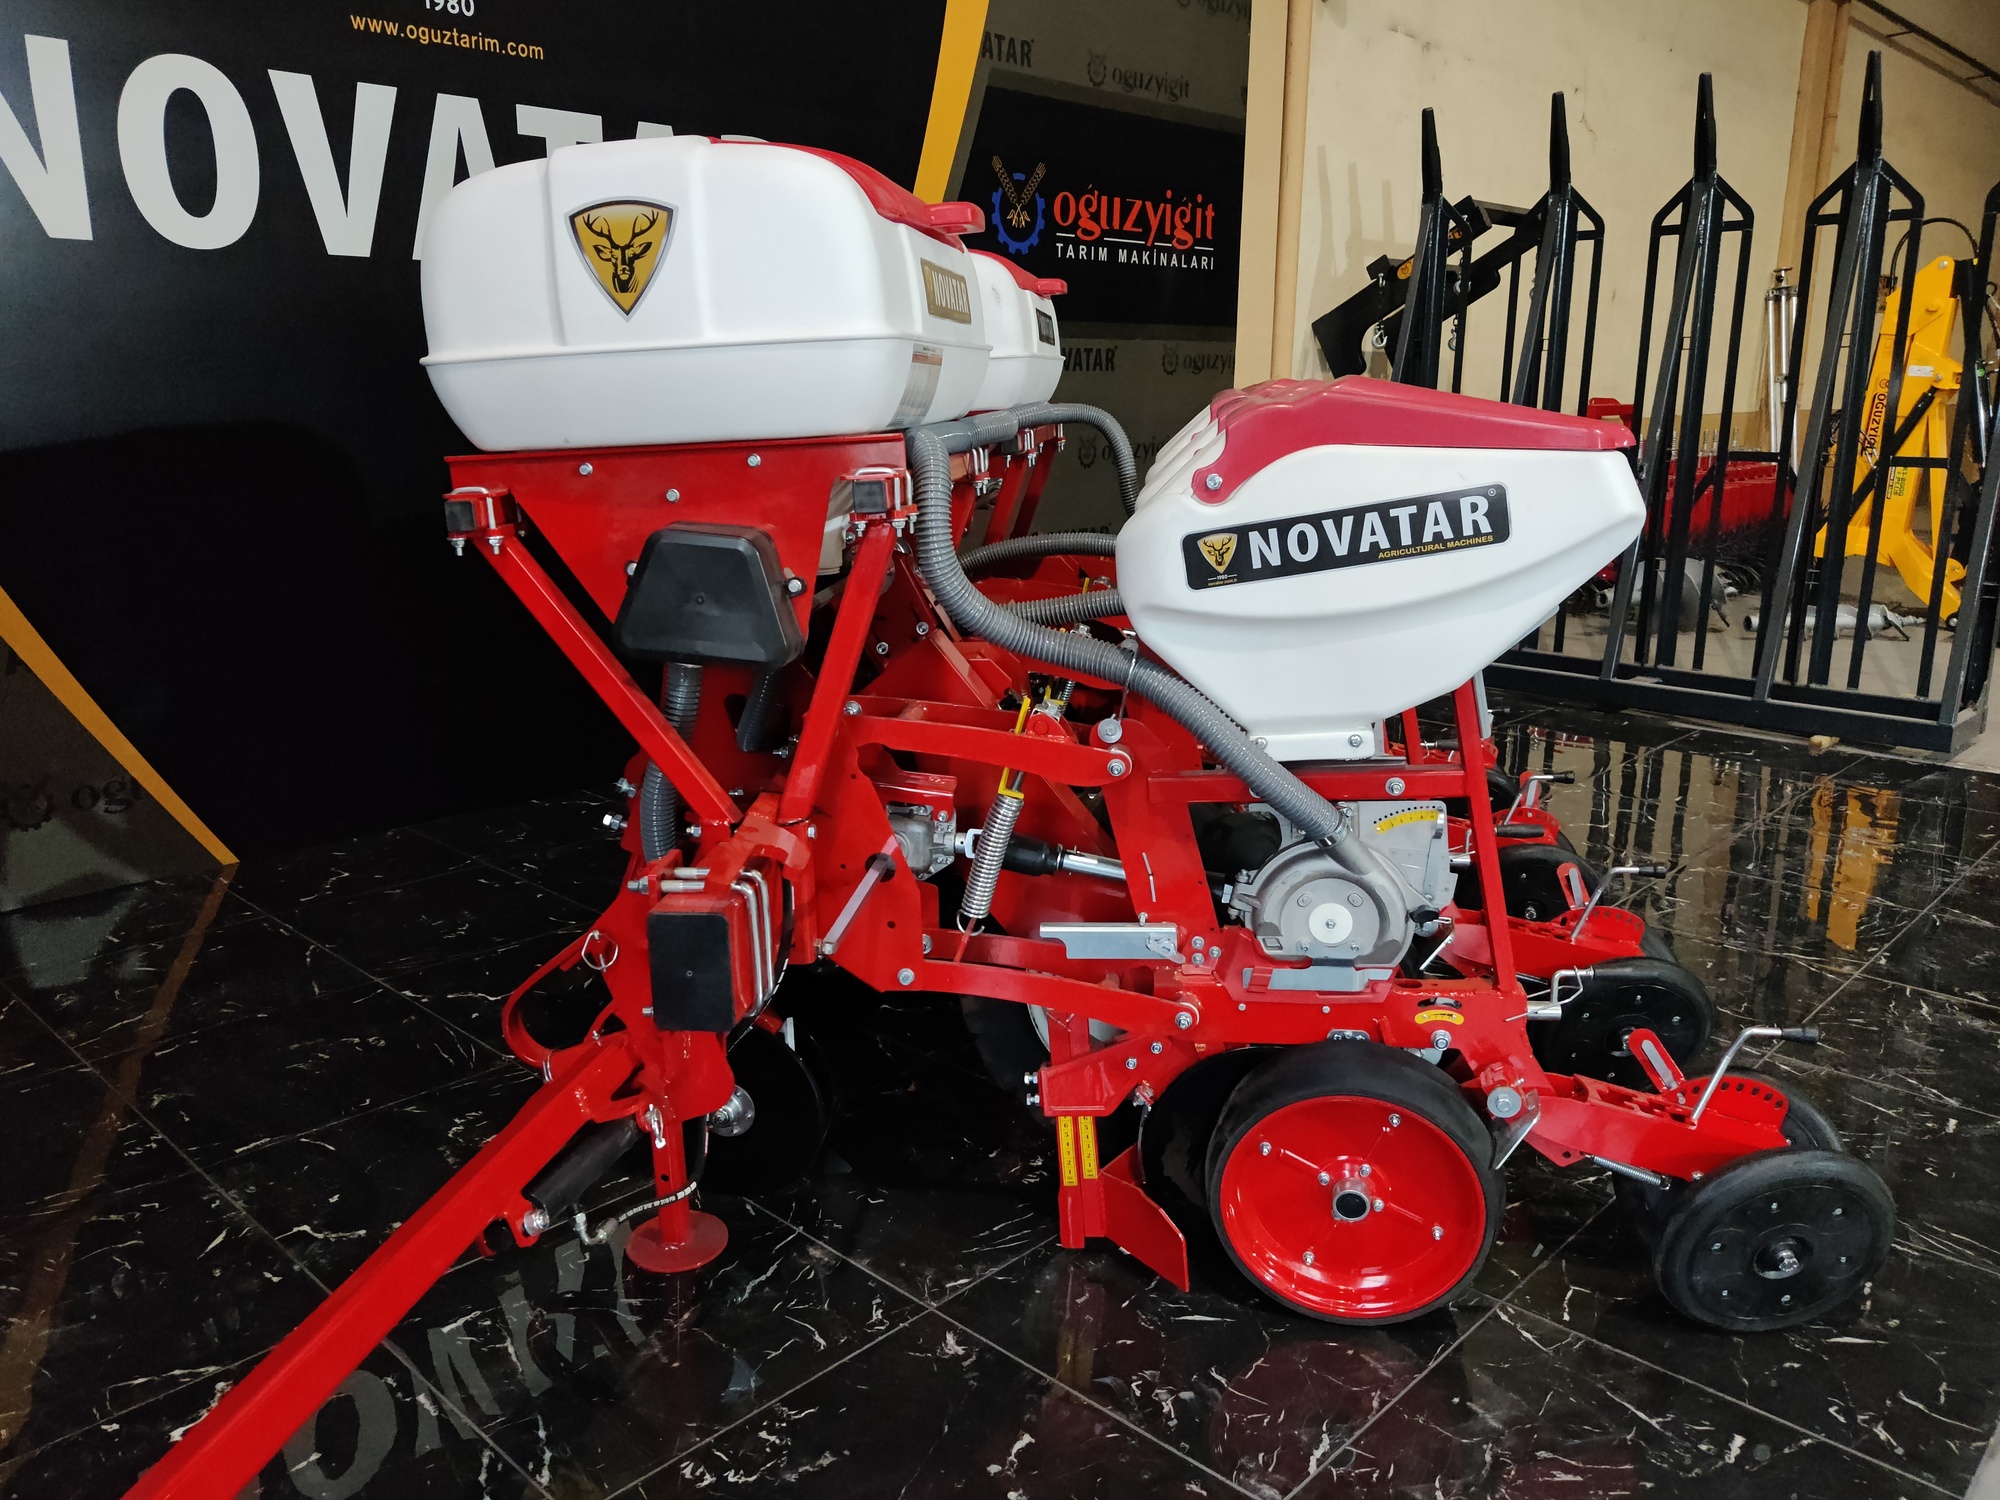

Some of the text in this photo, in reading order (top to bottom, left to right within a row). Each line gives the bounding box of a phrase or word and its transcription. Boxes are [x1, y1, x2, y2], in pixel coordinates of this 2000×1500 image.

[350, 14, 544, 60] www.oguztarim.com
[0, 33, 776, 261] NOVAT
[1055, 243, 1214, 270] TARIM MAKİNALARI
[931, 269, 970, 315] NOVATAR
[1248, 494, 1494, 570] NOVATAR
[1377, 534, 1494, 560] AGRICULTURAL MACHINES
